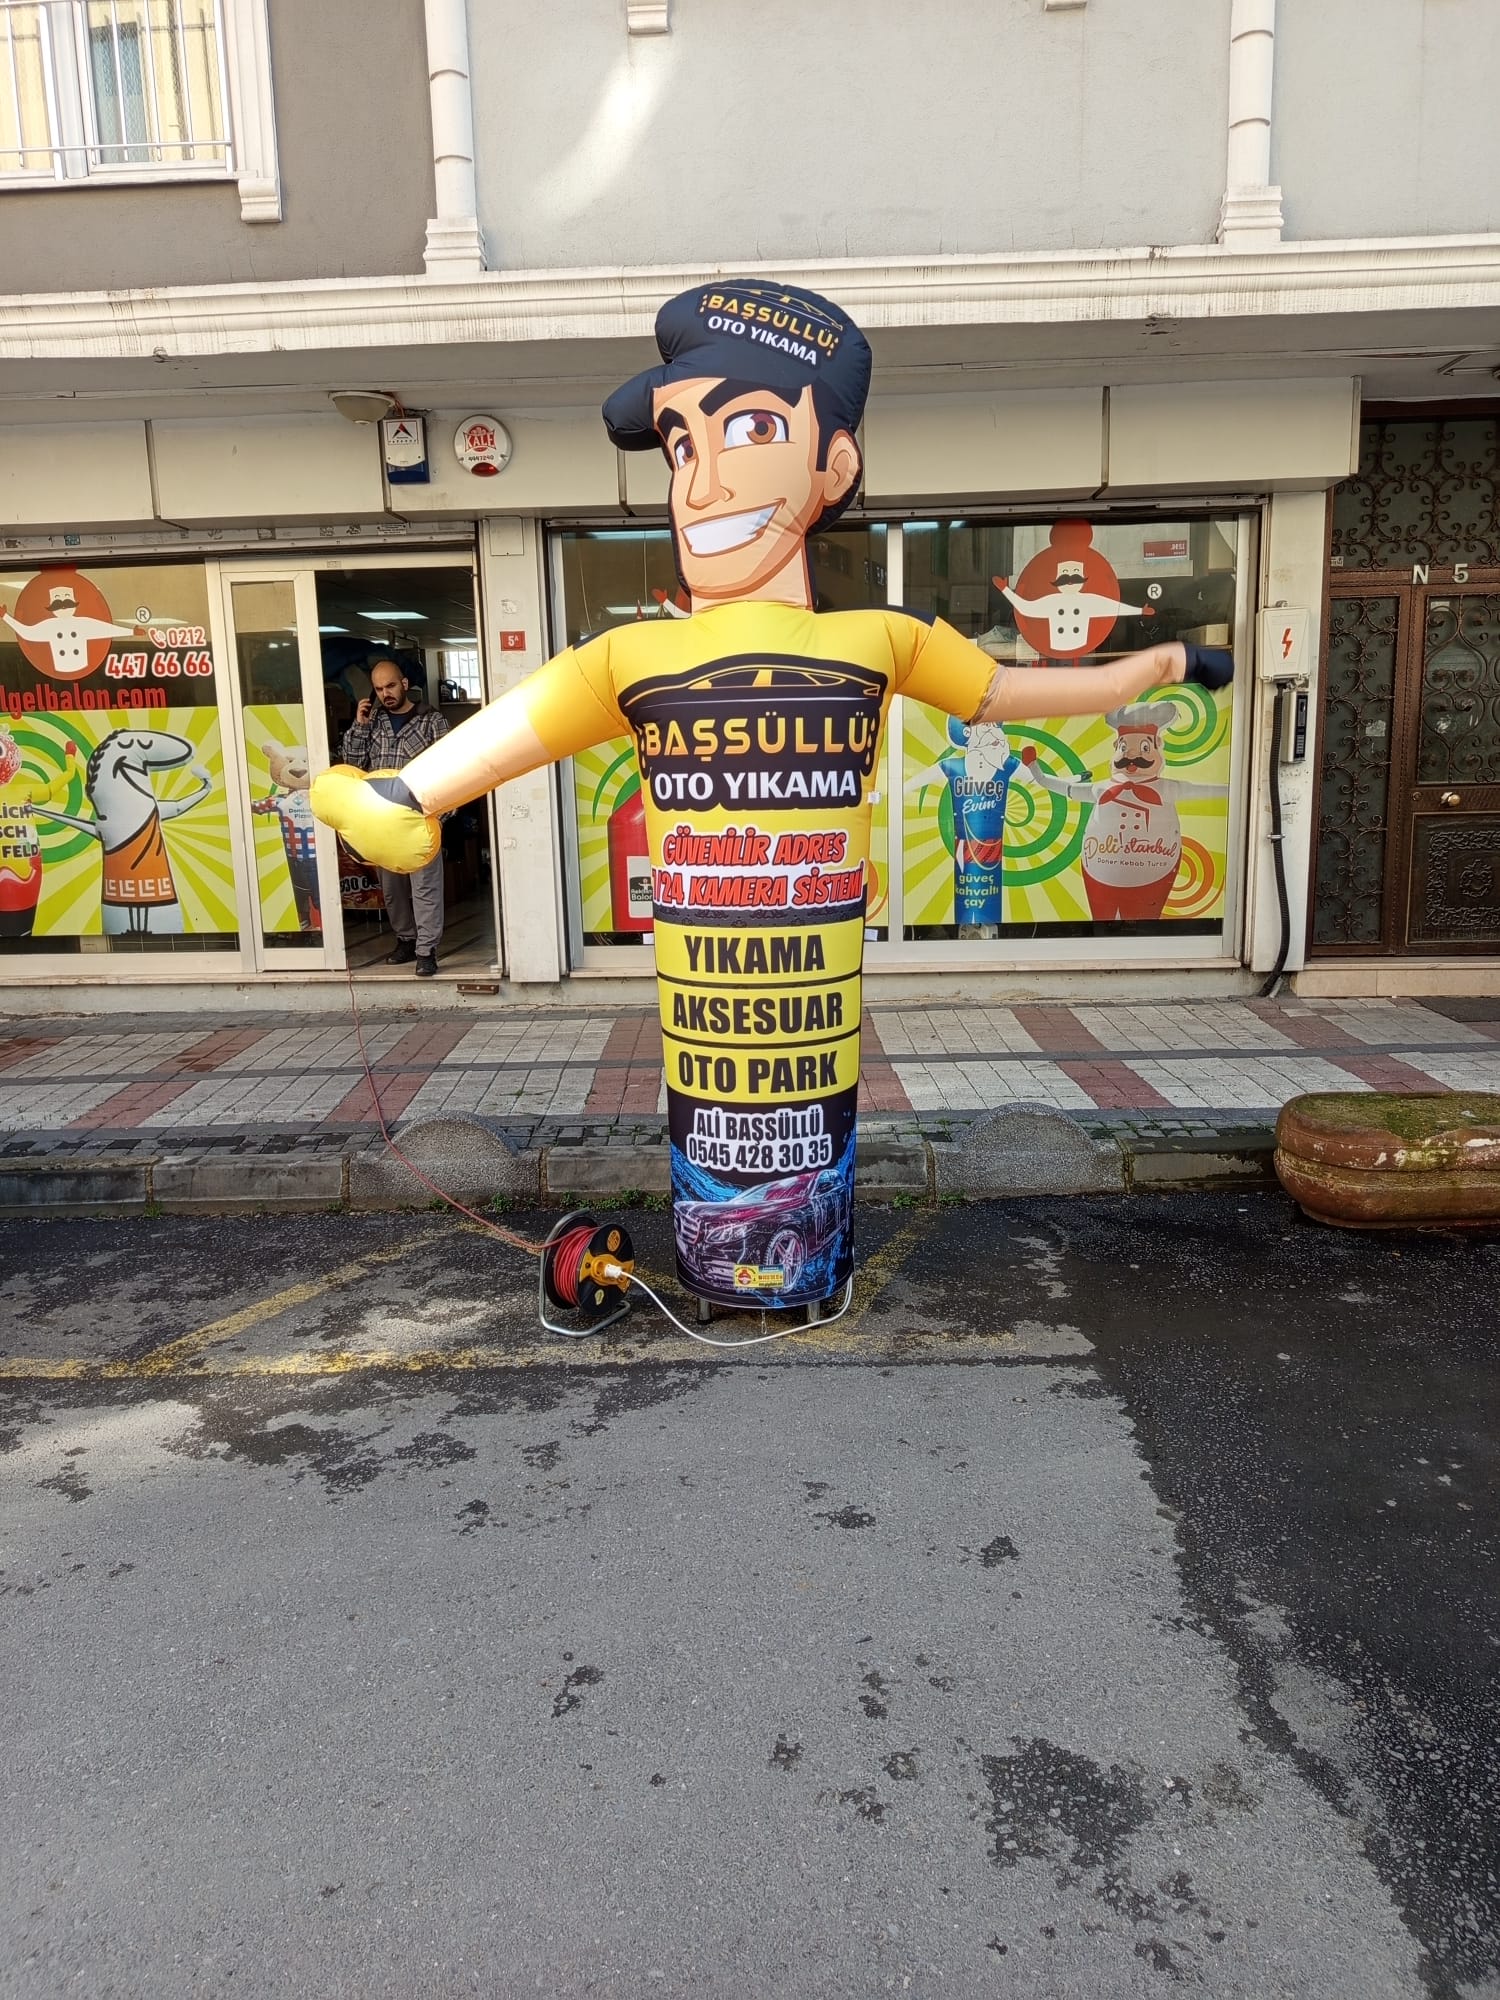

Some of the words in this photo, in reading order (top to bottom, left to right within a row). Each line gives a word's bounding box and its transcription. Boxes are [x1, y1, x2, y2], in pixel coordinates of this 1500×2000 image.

[707, 294, 833, 348] BAŞSÜLLÜ
[708, 315, 746, 335] OTO
[750, 325, 817, 366] YIKAMA
[463, 429, 497, 452] KALE
[1412, 564, 1430, 585] N
[1452, 563, 1469, 584] 5
[167, 627, 206, 648] 0212
[106, 653, 147, 678] 447
[152, 652, 181, 677] 66
[184, 651, 213, 676] 66
[645, 711, 869, 762] BAŞSÜLLÜ
[654, 772, 714, 800] OTO
[723, 769, 857, 800] YIKAMA
[954, 776, 1005, 801] Güveç
[2, 844, 39, 858] FELD
[664, 826, 771, 866] GÜVENİLİR
[773, 832, 847, 866] ADRES
[689, 875, 788, 908] KAMERA
[684, 934, 826, 975] YIKAMA
[673, 991, 843, 1035] AKSESUAR
[678, 1050, 737, 1093] OTO
[747, 1050, 838, 1094] PARK
[696, 1111, 721, 1138] ALİ
[725, 1109, 820, 1146] BAŞSÜLLÜ
[689, 1137, 731, 1167] 0545
[735, 1144, 774, 1169] 428
[778, 1142, 804, 1168] 30
[808, 1137, 830, 1165] 35
